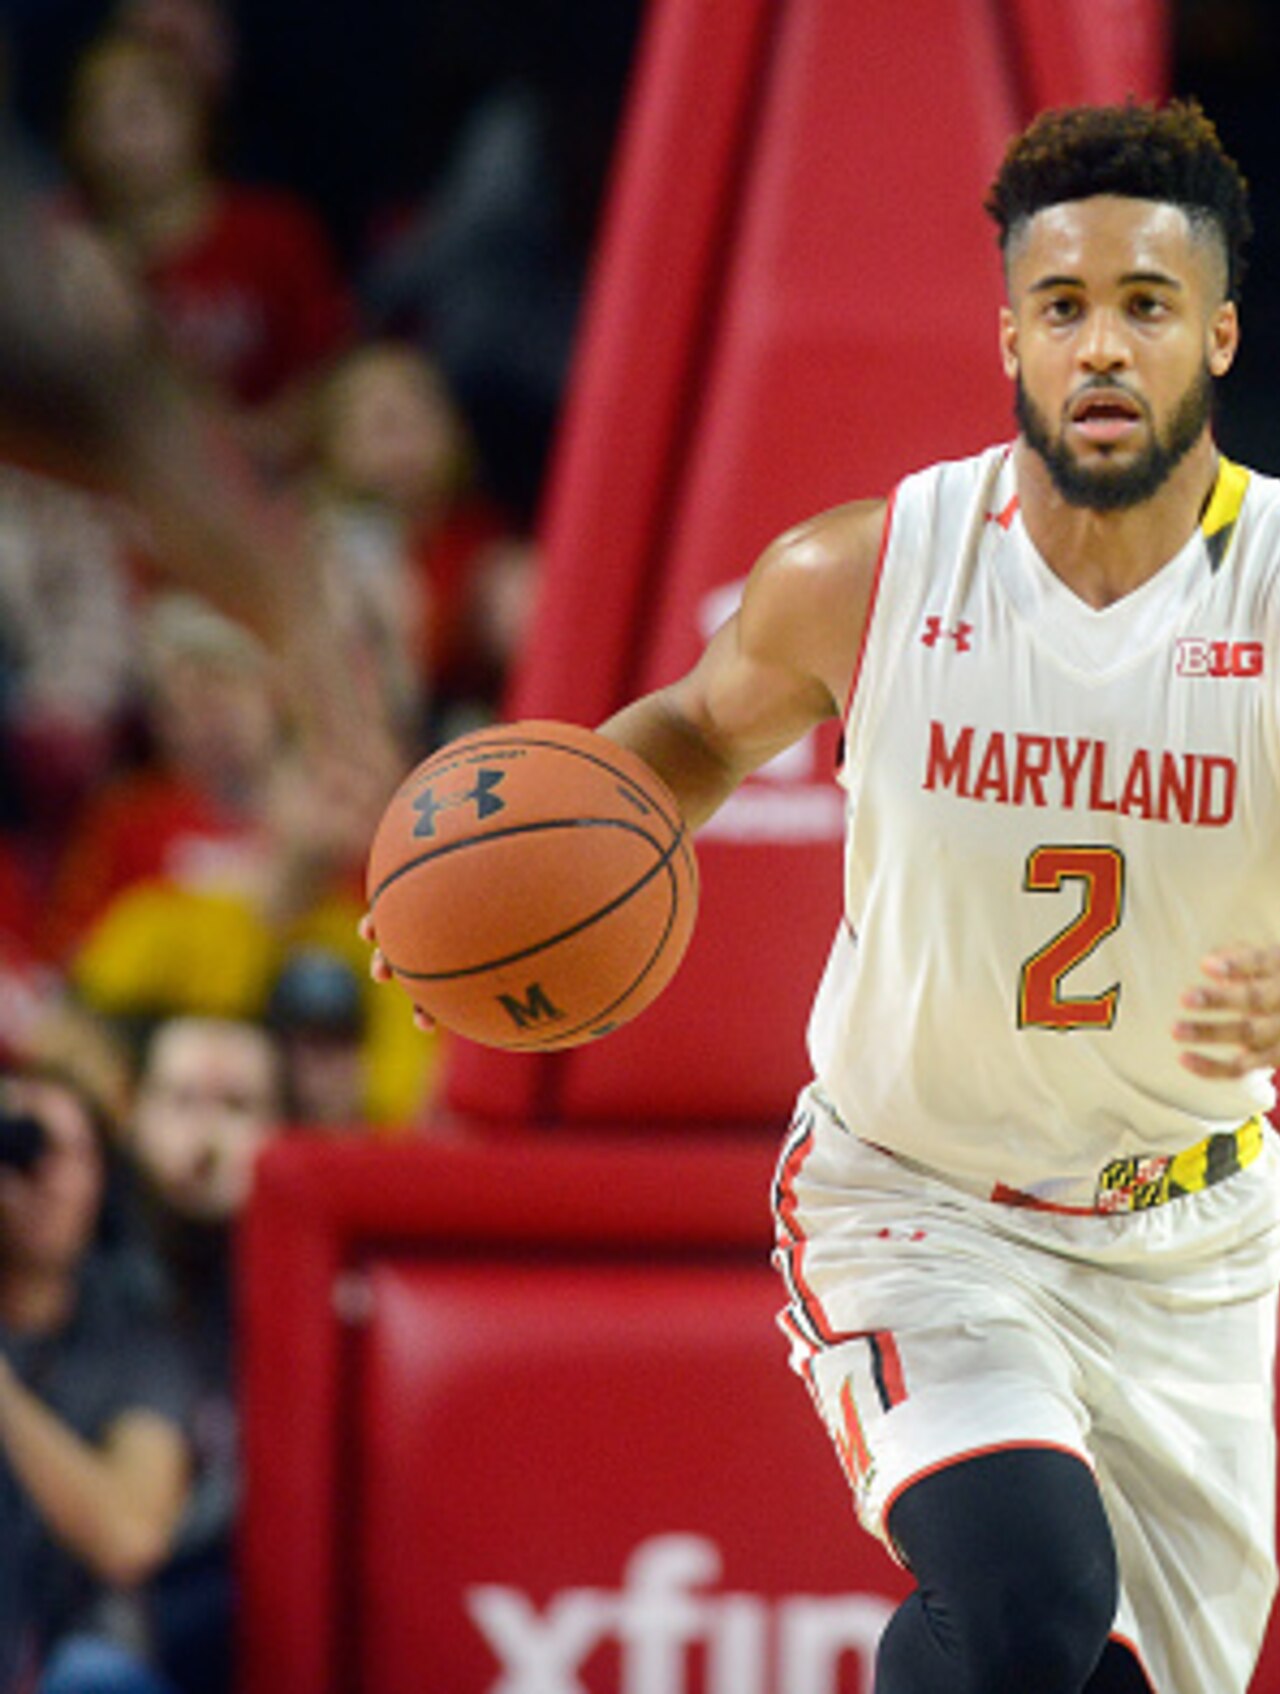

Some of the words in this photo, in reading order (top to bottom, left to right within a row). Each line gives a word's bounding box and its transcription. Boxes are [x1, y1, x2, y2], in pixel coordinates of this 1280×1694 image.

[922, 720, 1237, 828] MARYLAND
[1016, 844, 1125, 1031] 2
[495, 982, 567, 1031] M
